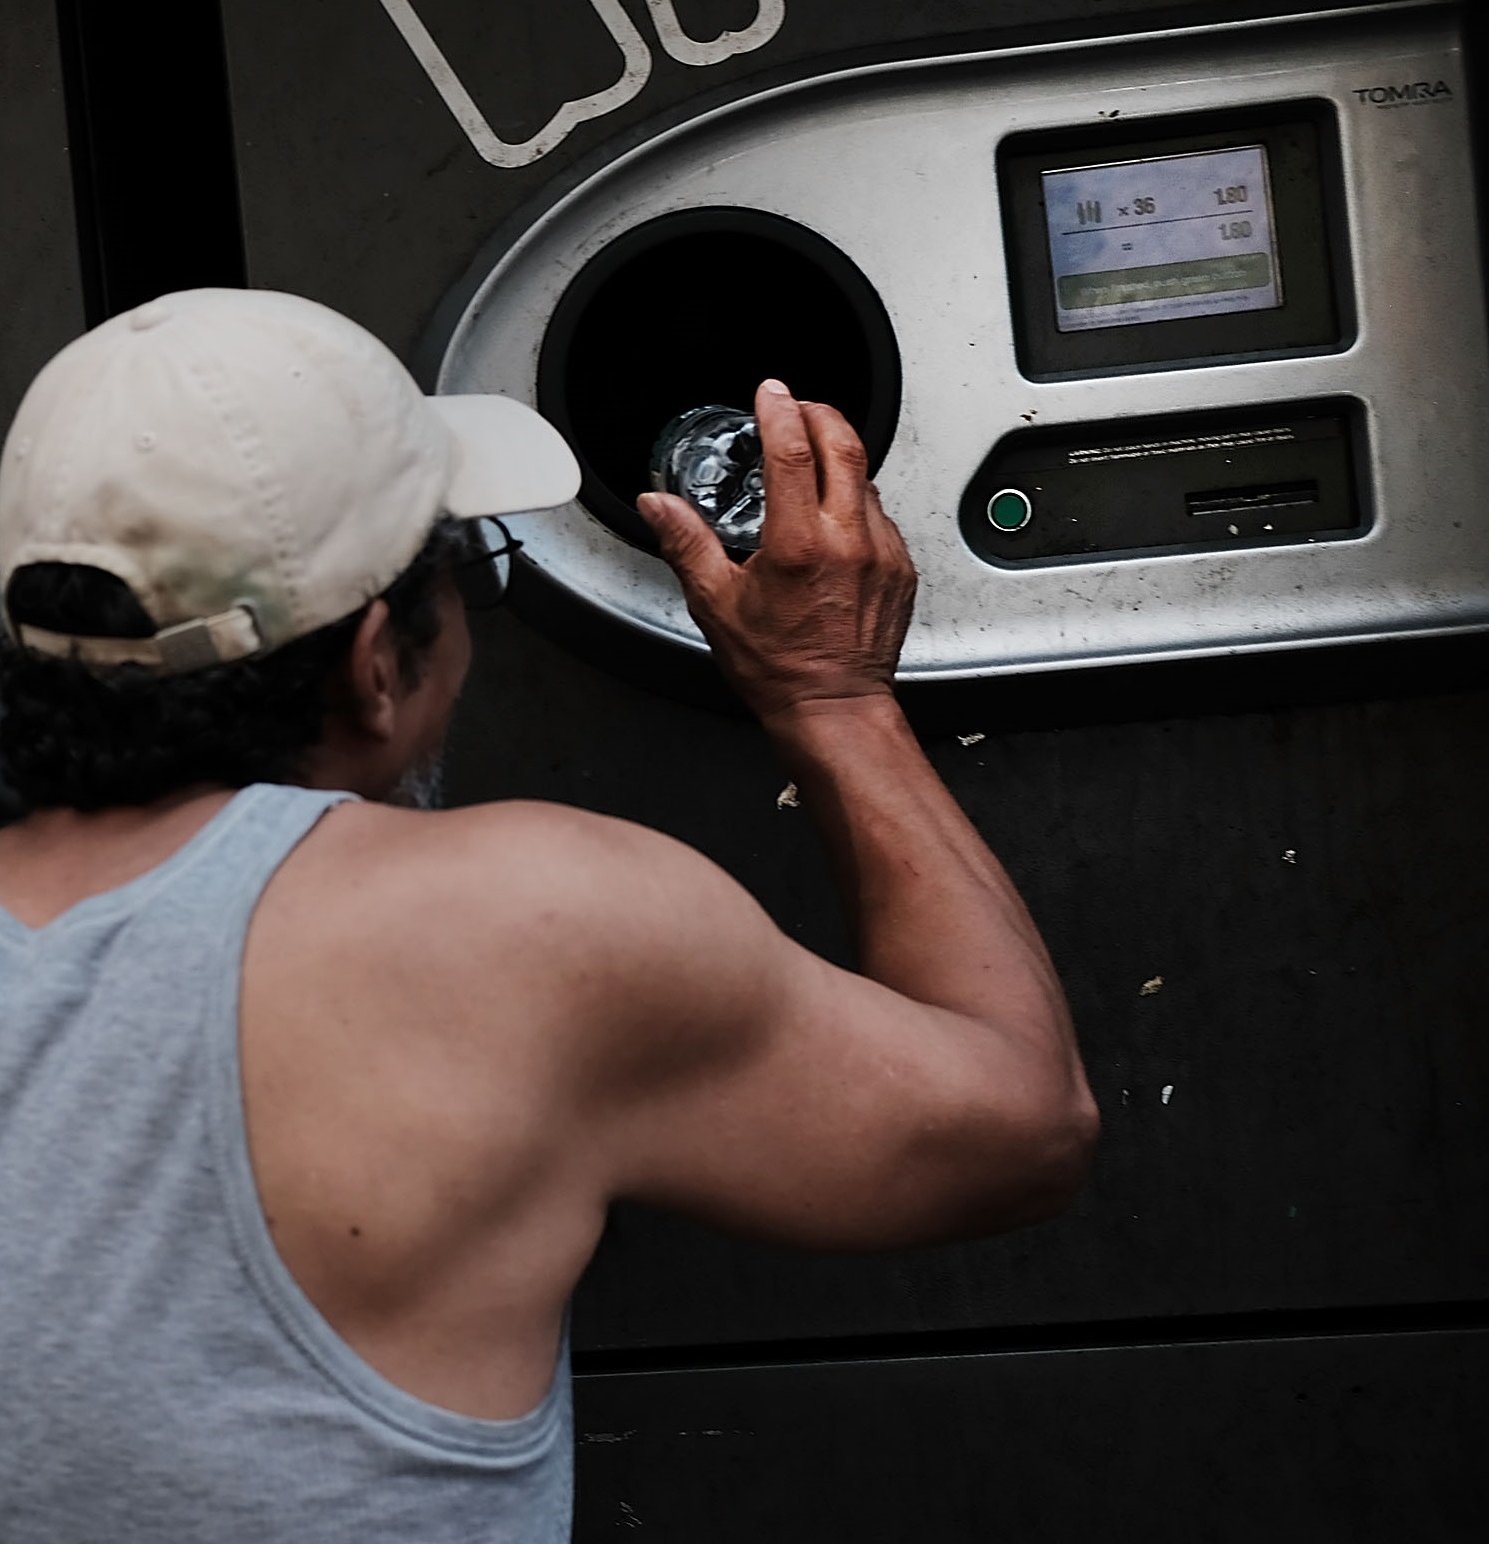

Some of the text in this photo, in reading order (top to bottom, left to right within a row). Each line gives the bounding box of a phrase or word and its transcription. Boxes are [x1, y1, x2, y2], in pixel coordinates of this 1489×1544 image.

[1352, 80, 1452, 104] TOMRA
[1133, 196, 1157, 216] 36
[1213, 185, 1248, 206] 1.80
